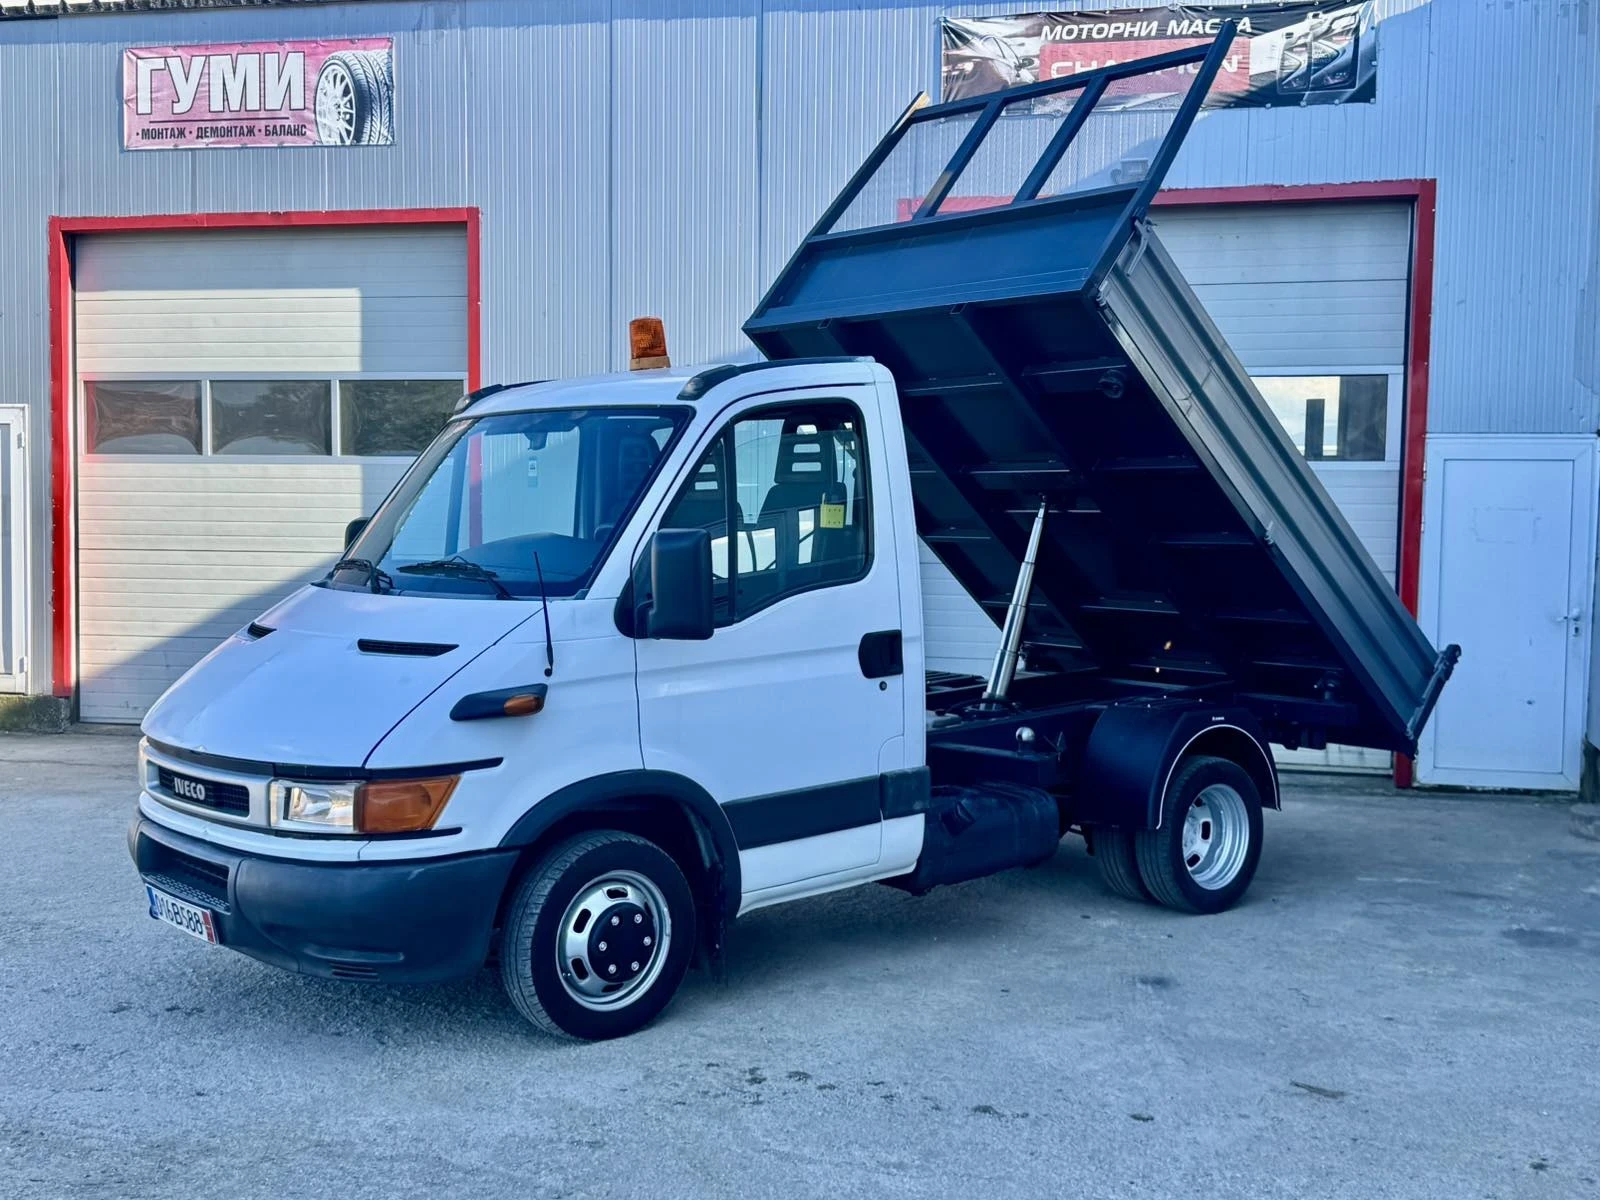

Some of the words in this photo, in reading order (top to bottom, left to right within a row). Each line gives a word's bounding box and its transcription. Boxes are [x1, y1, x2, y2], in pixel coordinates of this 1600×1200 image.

[1040, 21, 1160, 41] МОТОРНИ
[1166, 16, 1252, 36] МАСА
[136, 51, 306, 115] ГУМИ
[141, 127, 187, 140] МОНТАЖ
[195, 126, 256, 139] ДЕМОНТАЖ
[264, 124, 307, 138] БАЛАНС
[174, 777, 206, 801] IVECO
